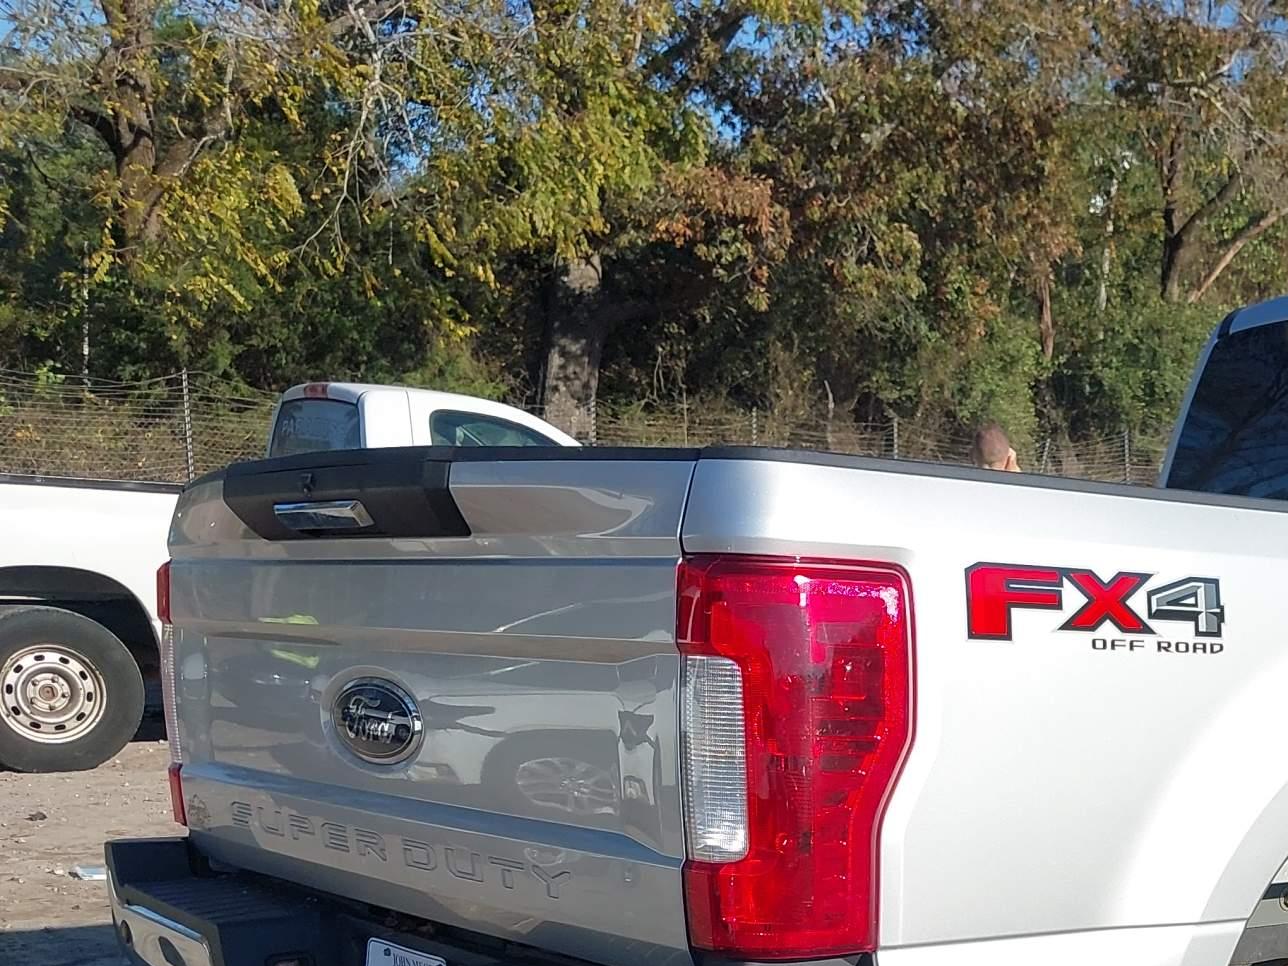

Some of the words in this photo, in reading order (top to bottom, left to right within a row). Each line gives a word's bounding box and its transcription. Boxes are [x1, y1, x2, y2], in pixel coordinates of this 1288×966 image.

[964, 561, 1225, 641] FX4
[1091, 638, 1145, 651] OFF
[1156, 640, 1224, 655] ROAD
[230, 801, 388, 861] SUPER
[401, 838, 571, 900] DUTY
